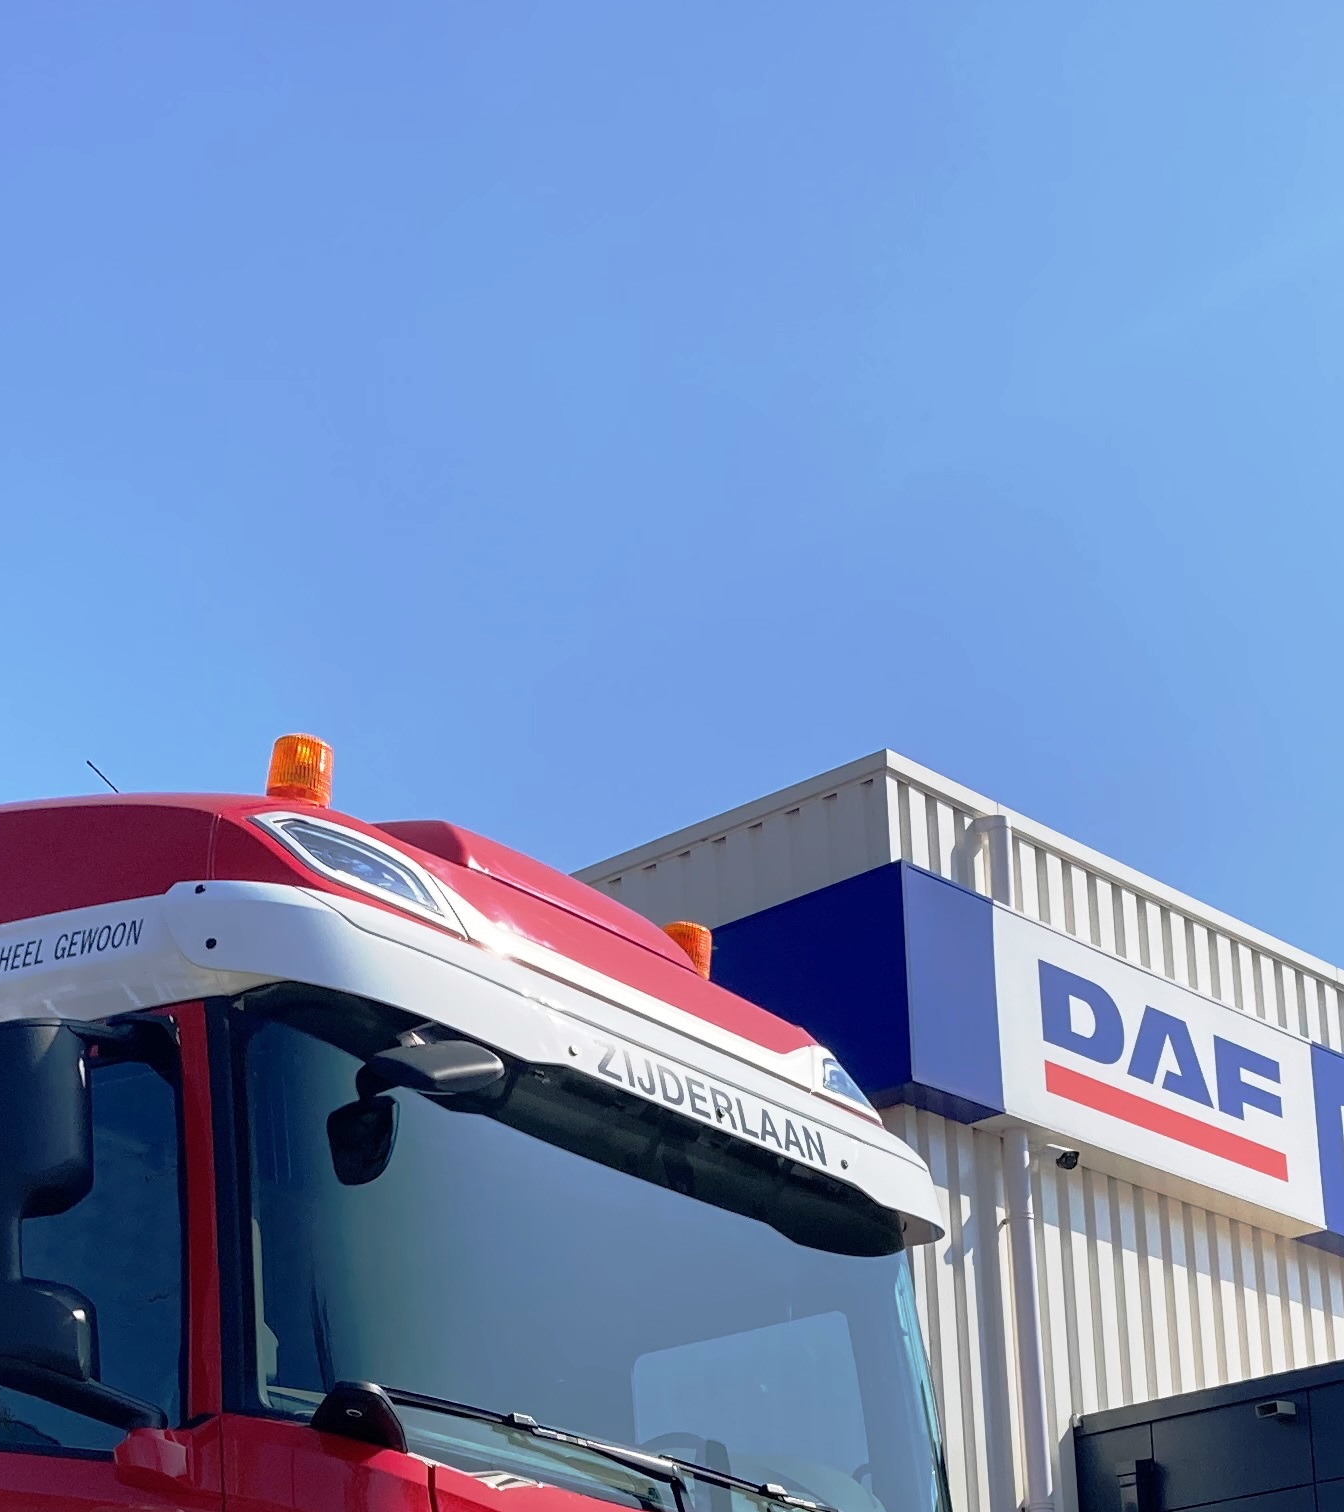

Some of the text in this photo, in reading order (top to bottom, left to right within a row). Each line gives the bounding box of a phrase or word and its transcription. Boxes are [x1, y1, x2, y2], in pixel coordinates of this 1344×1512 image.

[53, 918, 145, 960] GEWOON
[594, 1039, 827, 1167] ZIJDERLAAN
[1038, 959, 1283, 1121] DAF
